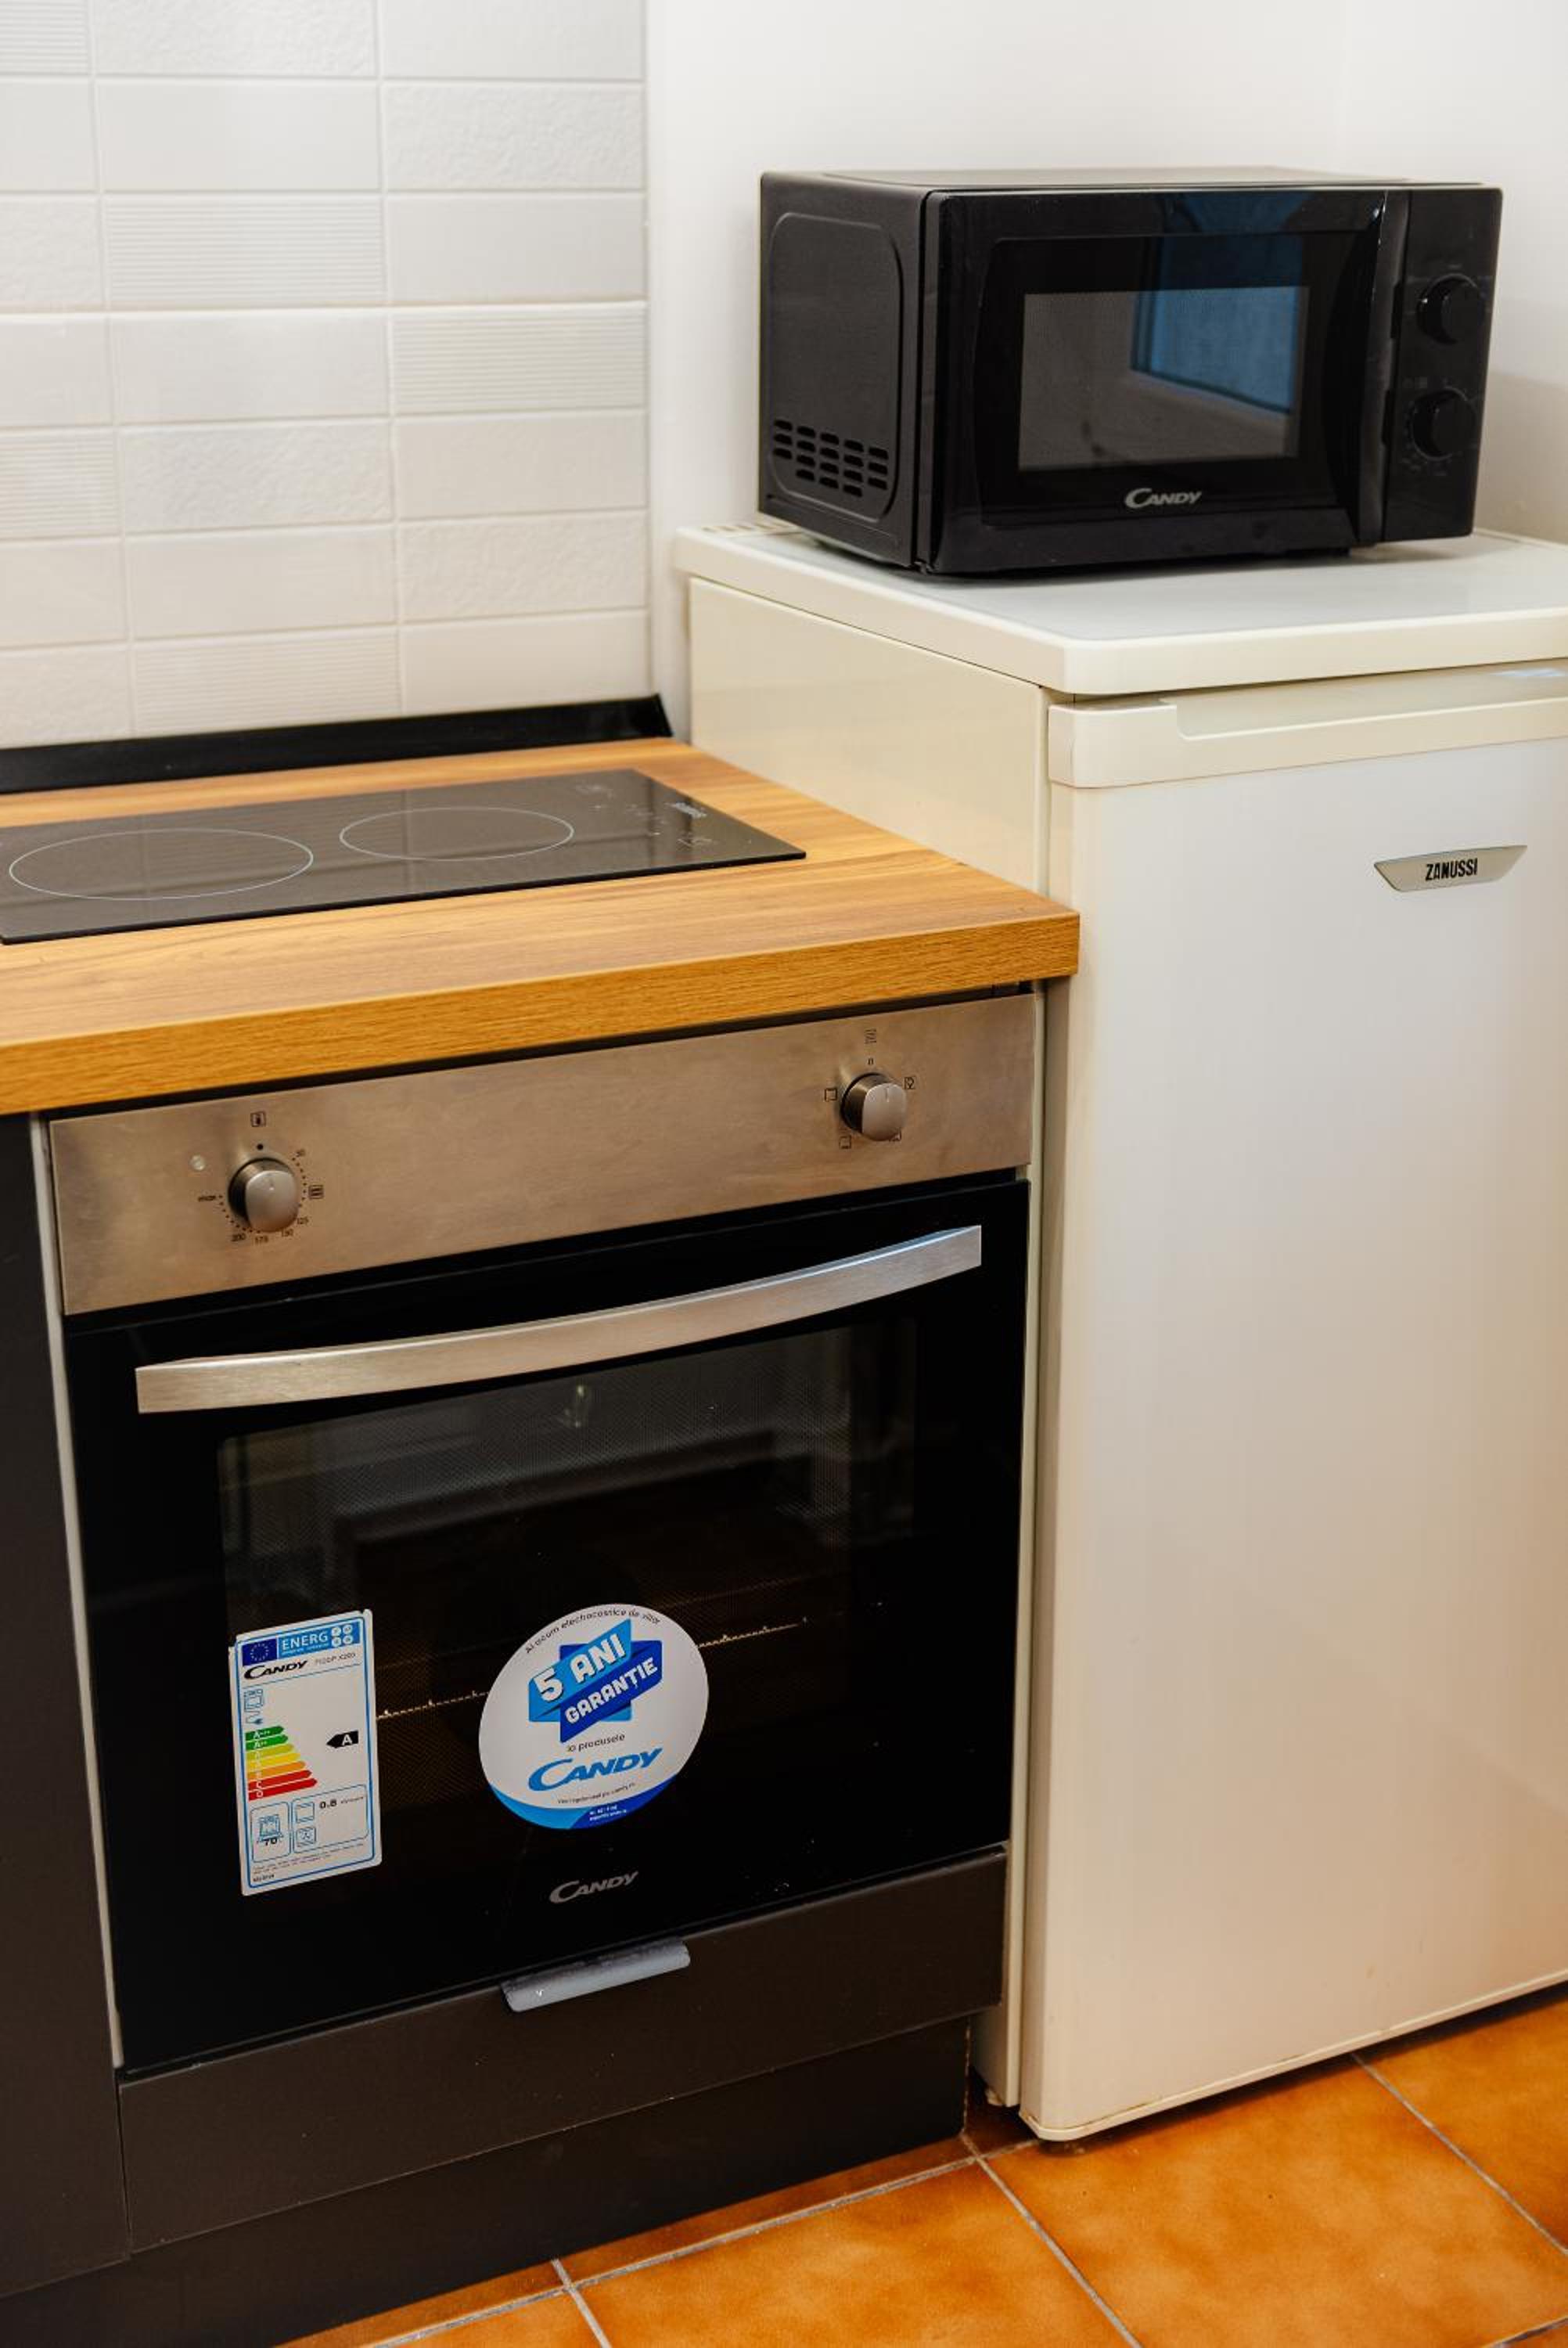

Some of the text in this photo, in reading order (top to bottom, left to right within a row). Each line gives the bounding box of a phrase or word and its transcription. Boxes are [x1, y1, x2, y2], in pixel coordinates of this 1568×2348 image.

[1124, 487, 1203, 509] CANDY
[1425, 858, 1478, 882] ZANUSSI
[282, 1631, 328, 1651] ENERG
[243, 1660, 307, 1680] CANDY
[533, 1633, 627, 1702] 5 ANI
[342, 1734, 352, 1745] A
[528, 1748, 663, 1792] CANDY
[549, 1871, 639, 1903] CANDY
